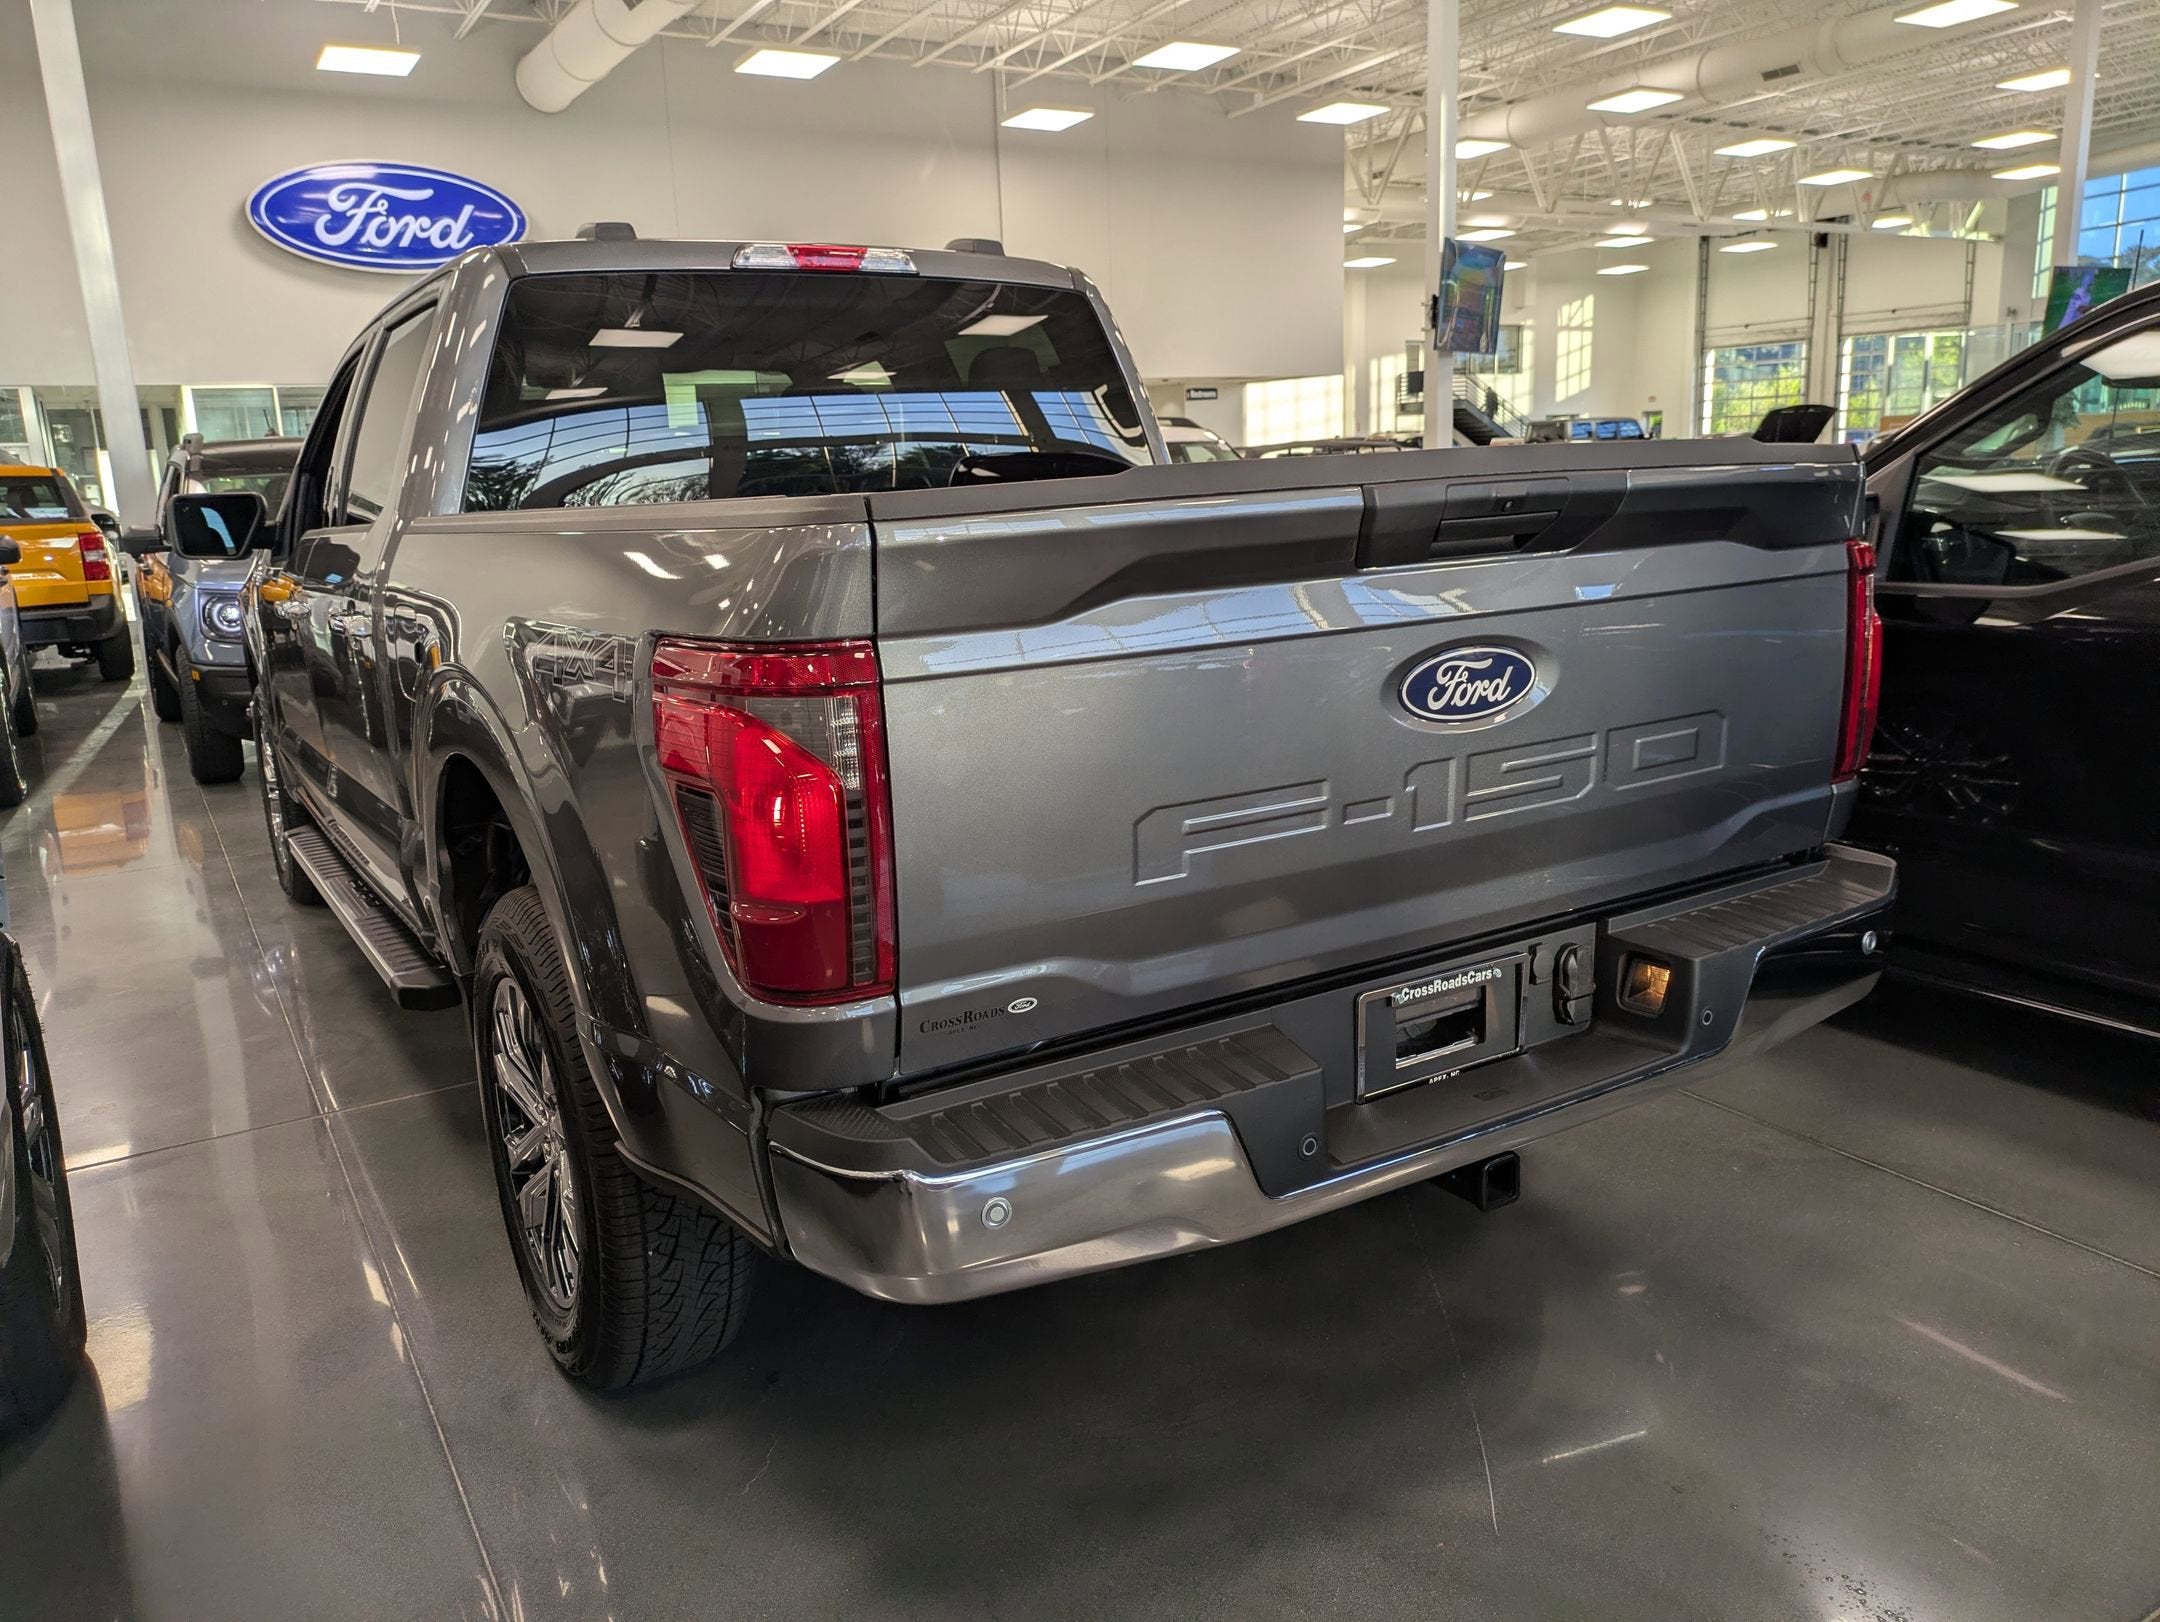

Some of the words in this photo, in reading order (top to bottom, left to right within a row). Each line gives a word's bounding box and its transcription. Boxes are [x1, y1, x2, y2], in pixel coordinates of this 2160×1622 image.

[315, 181, 475, 250] Ford
[1427, 656, 1515, 712] Ford
[1131, 708, 1729, 887] F-150
[1401, 968, 1493, 1001] CrossRoadsCars
